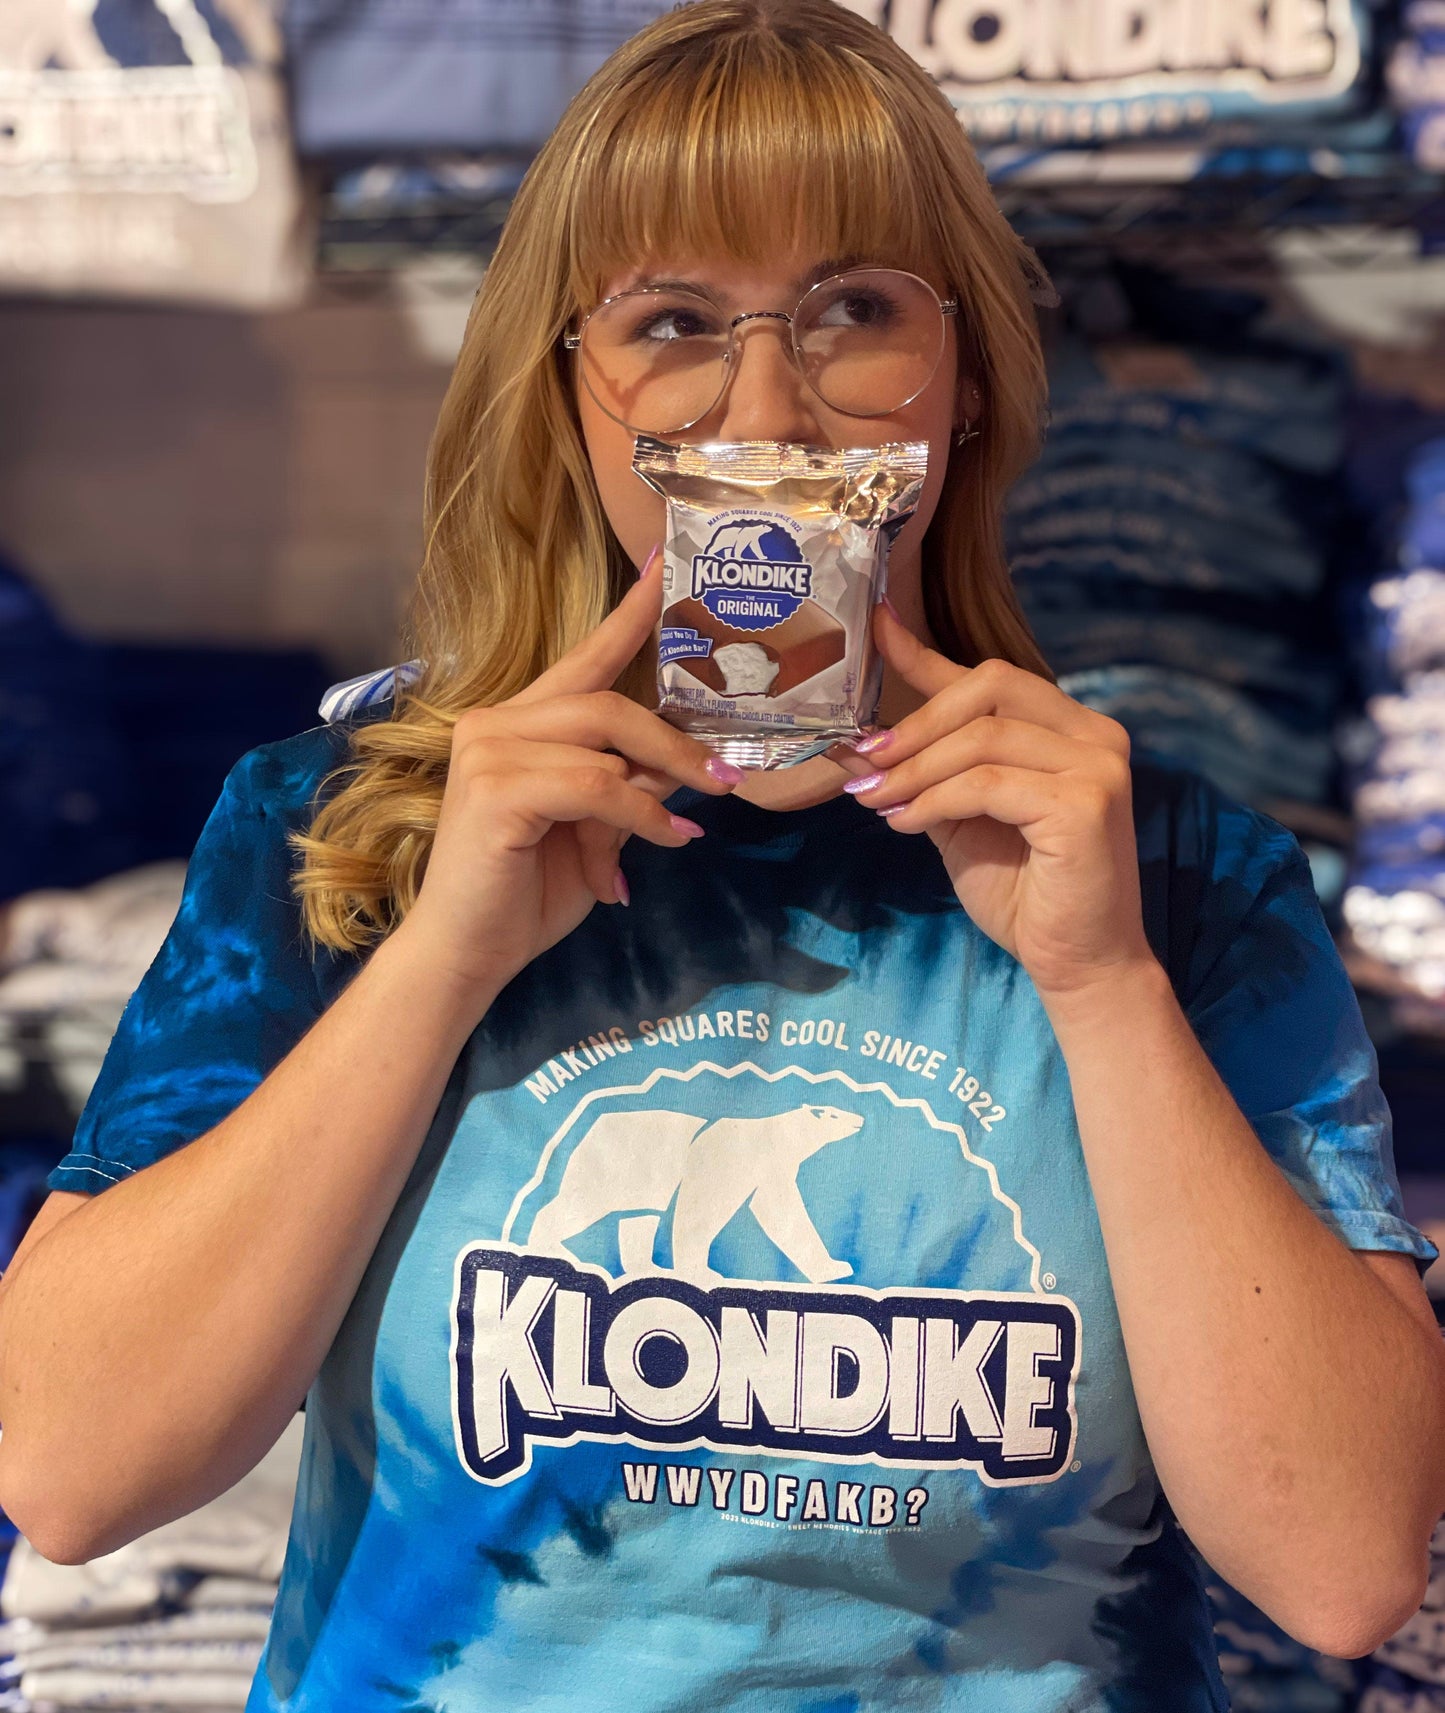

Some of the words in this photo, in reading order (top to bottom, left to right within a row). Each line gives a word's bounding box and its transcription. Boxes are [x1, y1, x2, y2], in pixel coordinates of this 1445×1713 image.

[707, 511, 730, 527] MAKING
[694, 557, 809, 596] KLONDIKE
[717, 600, 782, 618] ORIGINAL
[526, 1027, 633, 1104] MAKING
[642, 1010, 771, 1050] SQUARES
[781, 1018, 851, 1052] COOL
[859, 1030, 948, 1081] SINCE
[947, 1067, 1008, 1134] 1922
[472, 1268, 1064, 1467] KLONDIKE
[621, 1461, 931, 1529] WWYDFAKB?
